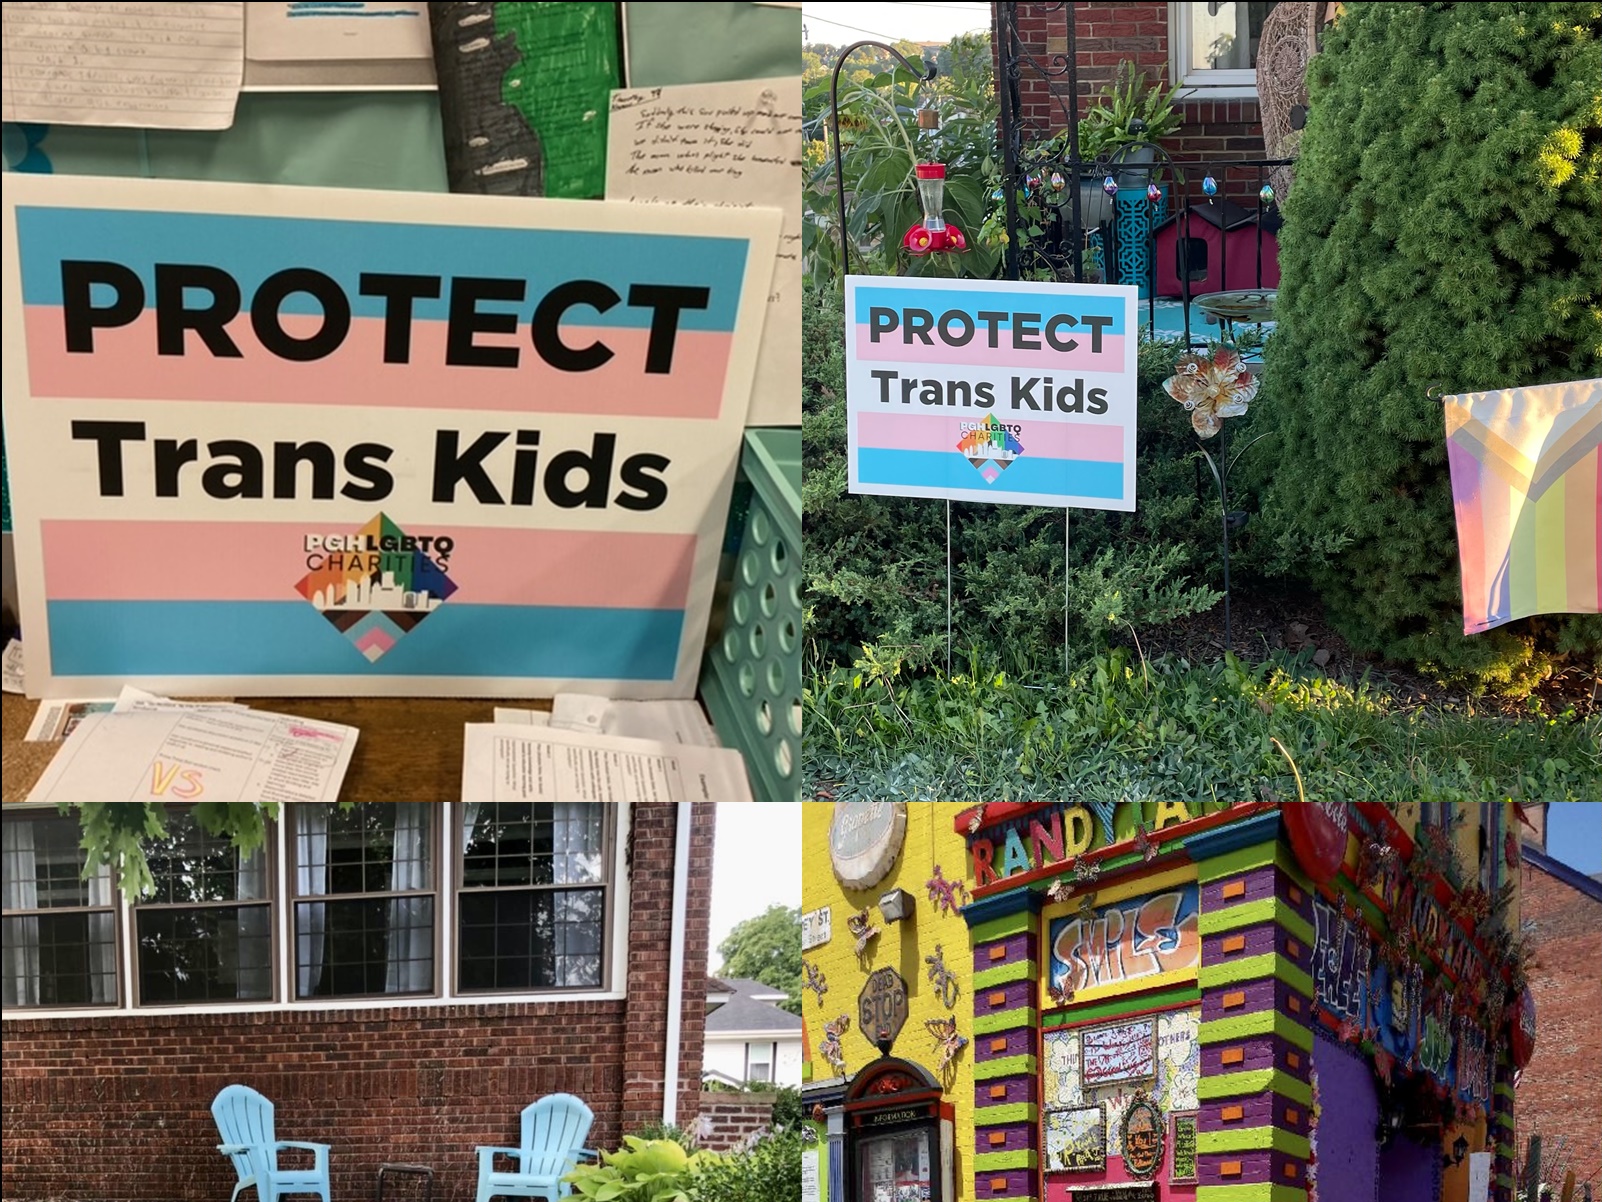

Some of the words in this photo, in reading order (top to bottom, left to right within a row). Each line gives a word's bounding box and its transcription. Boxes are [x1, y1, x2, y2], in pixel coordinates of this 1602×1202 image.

[60, 258, 710, 375] PROTECT
[869, 305, 1113, 354] PROTECT
[871, 368, 996, 409] Trans
[1011, 376, 1109, 415] Kids
[961, 431, 1020, 442] CHARITIES
[71, 419, 394, 502] Trans
[432, 428, 671, 511] Kids
[306, 553, 449, 574] CHARITIES
[972, 801, 1228, 888] RANDYLA
[861, 988, 904, 1026] STOP
